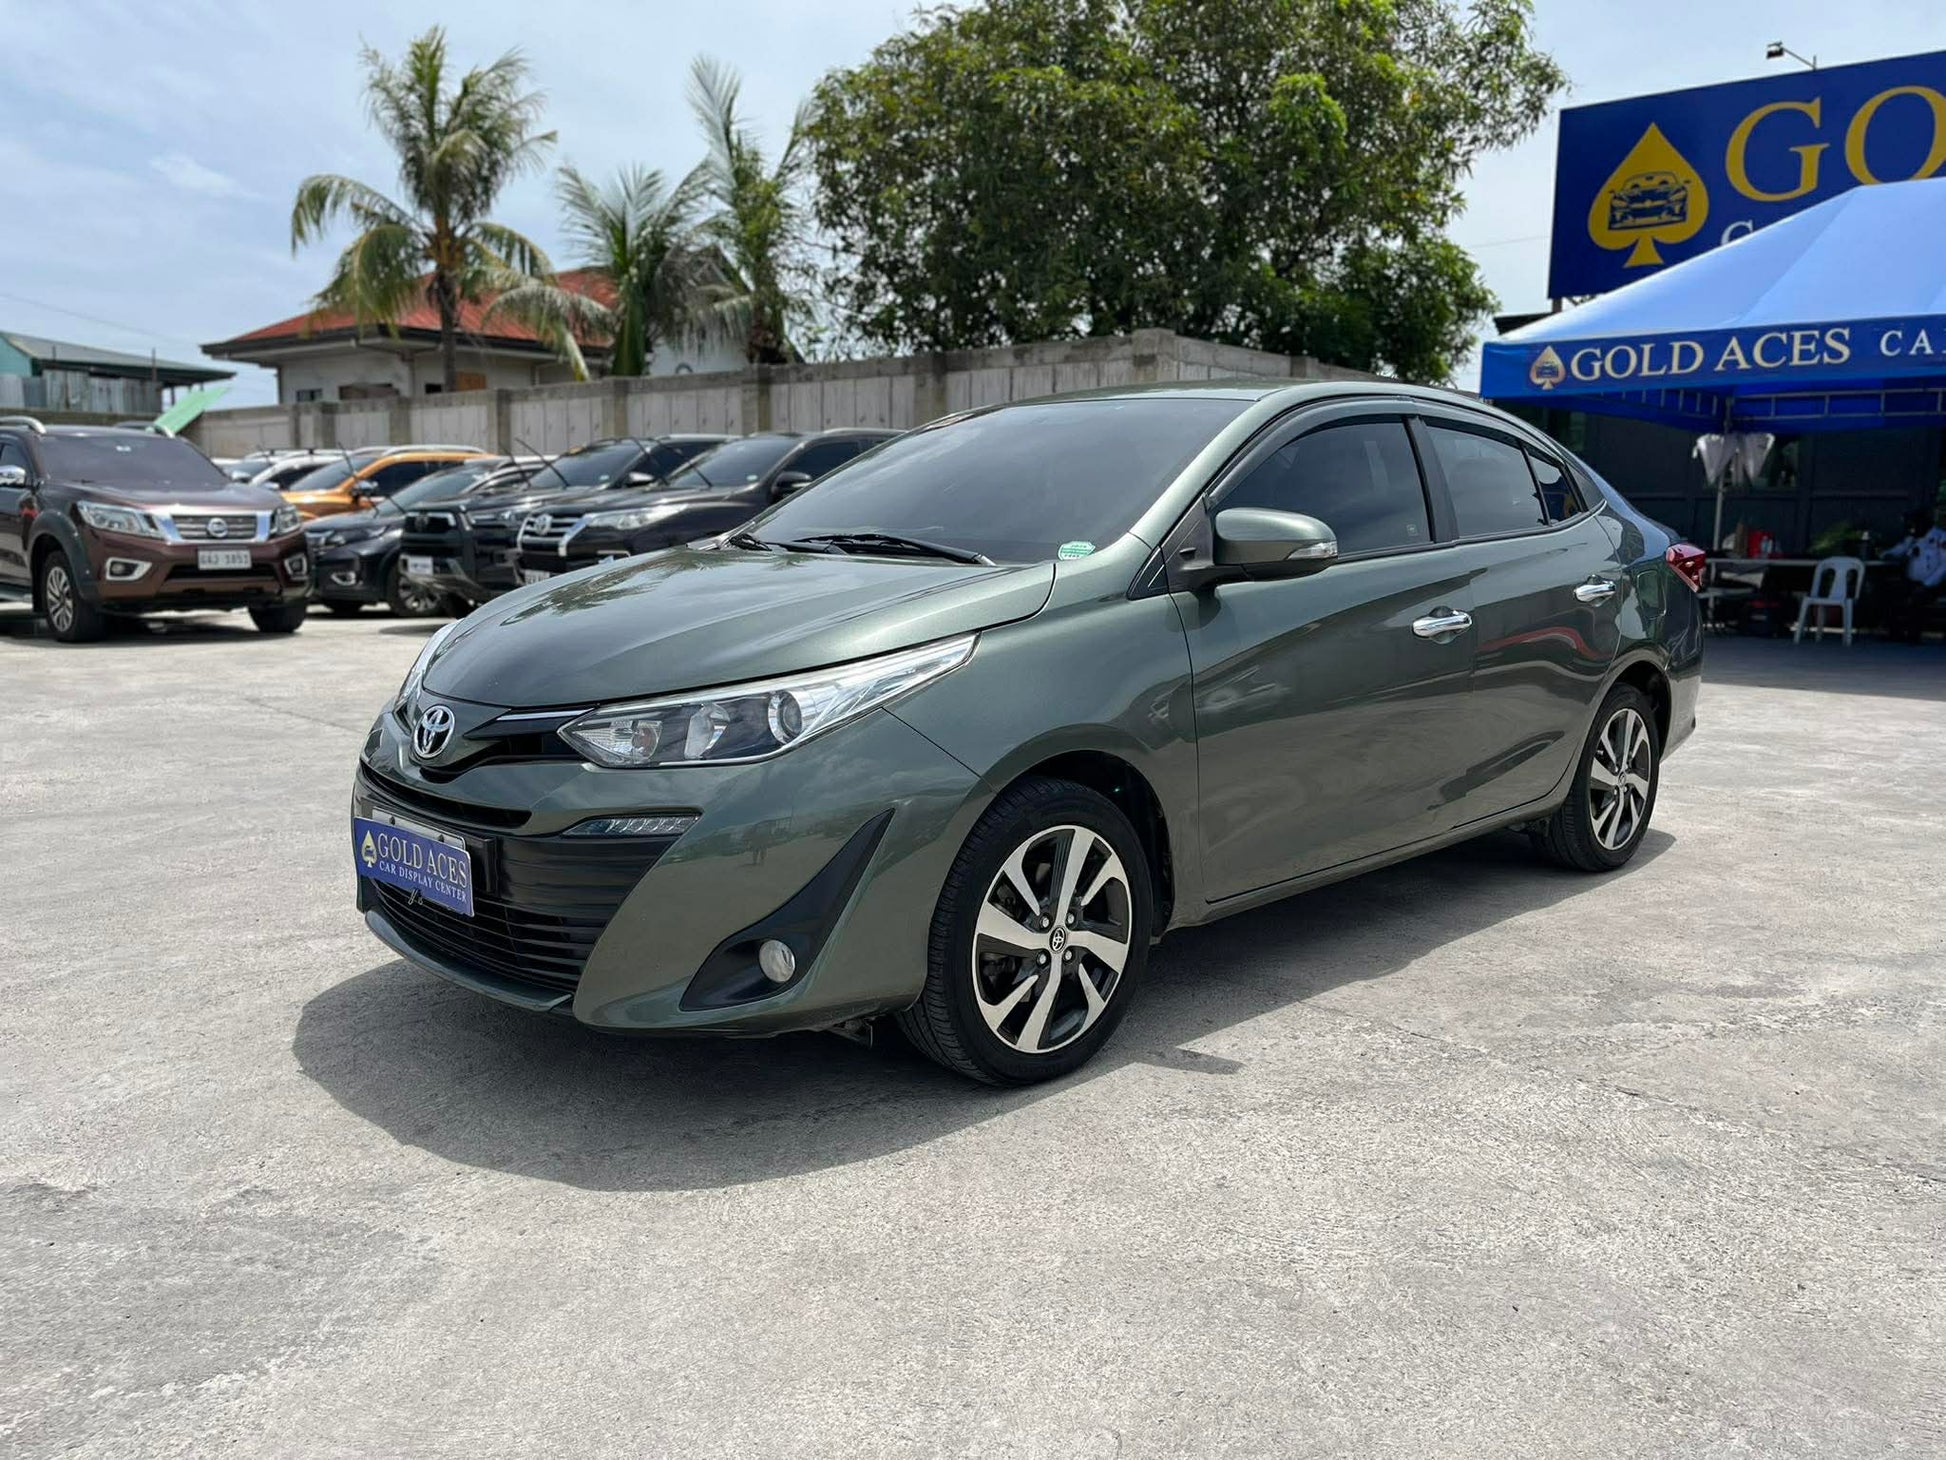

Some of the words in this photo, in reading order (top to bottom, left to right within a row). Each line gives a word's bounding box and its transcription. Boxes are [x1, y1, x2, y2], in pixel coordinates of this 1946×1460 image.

[1570, 340, 1704, 381] GOLD
[1714, 327, 1851, 372] ACES
[1879, 327, 1946, 357] CA
[377, 832, 423, 869] GOLD
[427, 848, 467, 889] ACES
[379, 860, 397, 876] CAR
[399, 866, 433, 889] DISPLAY
[434, 880, 467, 903] CENTER
